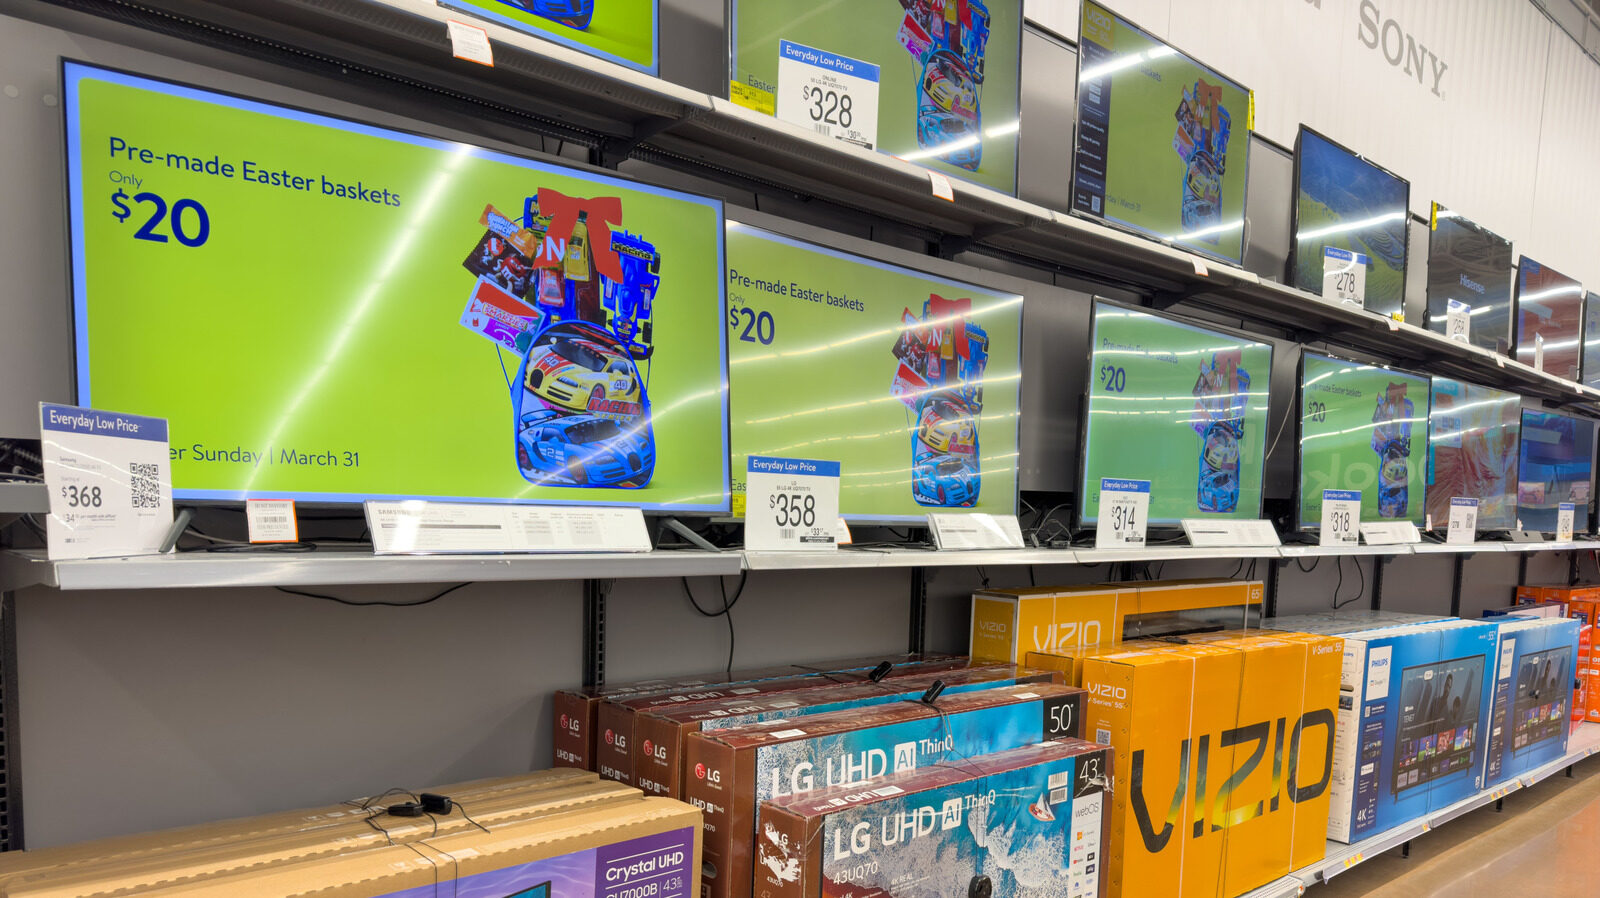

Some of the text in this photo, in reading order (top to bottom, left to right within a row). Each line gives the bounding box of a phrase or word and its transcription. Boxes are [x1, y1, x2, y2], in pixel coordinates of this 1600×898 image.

[1086, 8, 1112, 32] VIZIO
[786, 45, 854, 71] Everyday Low Price
[1357, 0, 1448, 97] SONY
[748, 74, 776, 93] Easter
[802, 85, 853, 128] $328
[109, 136, 401, 207] Pre-made Easter baskets
[109, 170, 143, 189] Only
[110, 188, 210, 248] $20
[729, 269, 865, 312] Pre-made Easter baskets
[1460, 273, 1485, 295] Hisense
[729, 292, 746, 305] Only
[729, 305, 775, 345] $20
[1100, 365, 1126, 392] $20
[50, 409, 138, 433] Everyday Low Price
[1308, 401, 1326, 423] $20
[192, 444, 263, 468] Sunday
[280, 448, 338, 467] March
[342, 451, 360, 467] 31
[753, 459, 816, 472] Everyday Low Price
[1104, 480, 1121, 489] Everyday
[62, 485, 103, 508] $368
[769, 493, 816, 527] $358
[1111, 505, 1135, 530] $314
[1330, 511, 1350, 532] $318
[979, 619, 1006, 633] VIZIO
[1033, 620, 1101, 652] VIZIO
[1088, 682, 1127, 700] VIZIO
[728, 705, 765, 714] UHD
[569, 717, 580, 732] LG
[614, 733, 626, 748] LG
[654, 745, 666, 760] LG
[602, 765, 614, 779] UHD
[707, 768, 721, 783] LG
[771, 761, 814, 800] LG
[826, 748, 888, 787] UHD
[919, 734, 954, 755] ThinQ
[639, 776, 653, 791] UHD
[1131, 708, 1335, 853] VIZIO
[690, 796, 706, 810] UHD
[845, 791, 878, 802] UHD
[1074, 802, 1099, 819] webOS
[1357, 808, 1367, 822] 4K
[834, 821, 871, 861] LG
[881, 805, 936, 847] UHD
[964, 789, 996, 811] ThinQ
[605, 851, 684, 883] Crystal UHD
[833, 860, 879, 886] 43UQ70
